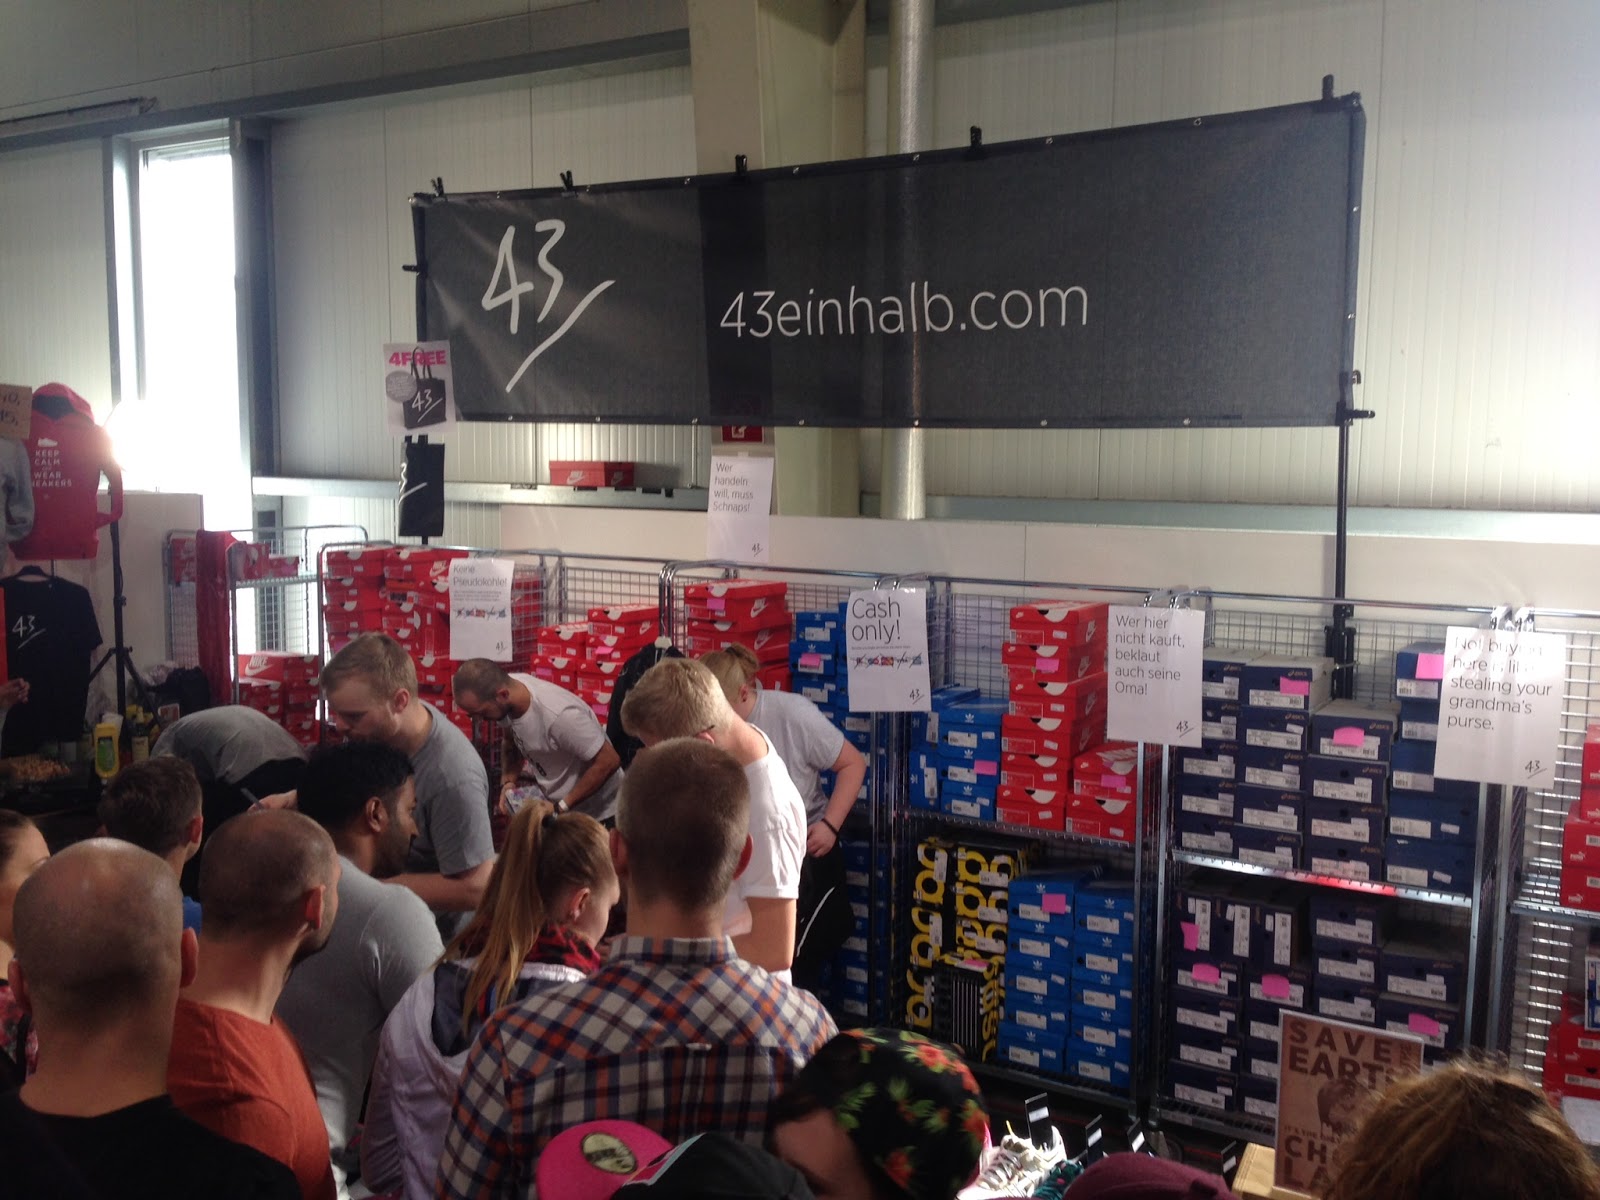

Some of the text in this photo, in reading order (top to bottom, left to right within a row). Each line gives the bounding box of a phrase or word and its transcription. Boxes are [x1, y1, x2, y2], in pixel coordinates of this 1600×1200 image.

[719, 280, 1089, 339] 43einhalb.com
[389, 350, 447, 366] 4FREE
[35, 449, 60, 458] KEEP
[34, 458, 61, 466] CALM
[715, 462, 733, 473] Wer
[33, 471, 62, 479] WEAR
[714, 475, 748, 487] handeln
[713, 488, 754, 500] will, muss
[713, 501, 751, 514] Schnaps!
[453, 564, 476, 574] Keine
[852, 596, 901, 619] Cash
[1115, 614, 1169, 629] Wer hier
[851, 619, 901, 645] only!
[1115, 632, 1185, 649] nicht kauft,
[1115, 647, 1161, 663] beklaut
[1115, 665, 1181, 681] auch seine
[1115, 681, 1148, 696] Oma!
[1450, 675, 1553, 697] stealing your
[1449, 695, 1533, 715] grandma's
[1447, 714, 1495, 731] purse.
[1288, 1019, 1393, 1065] SAVE
[1288, 1044, 1395, 1092] EART
